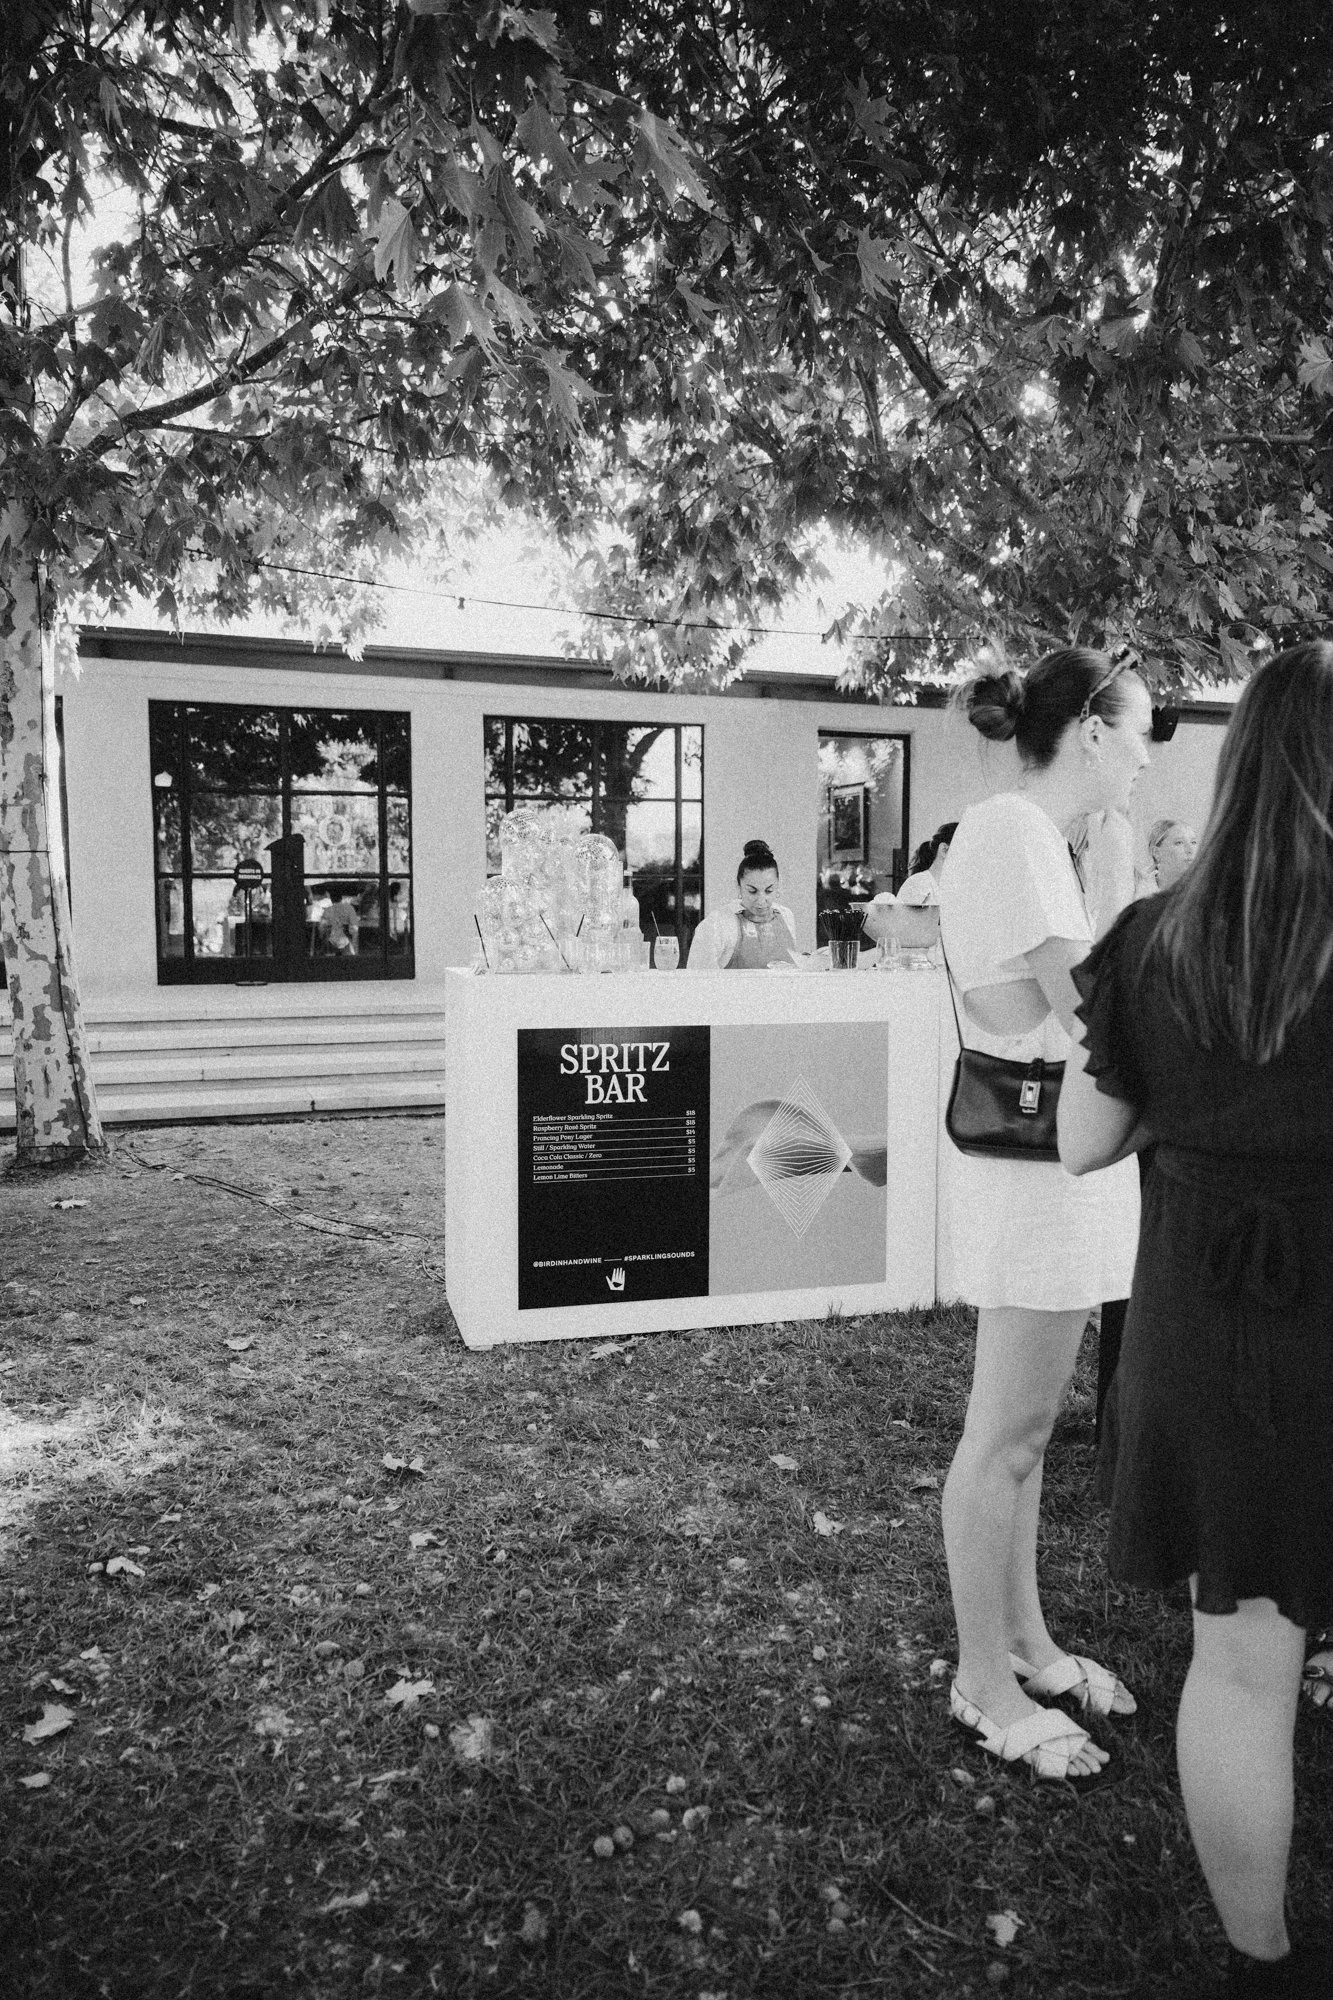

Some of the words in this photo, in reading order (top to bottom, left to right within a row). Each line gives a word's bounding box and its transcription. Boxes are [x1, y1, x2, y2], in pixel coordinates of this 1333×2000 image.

[560, 1042, 670, 1074] SPRITZ
[584, 1073, 648, 1104] BAR
[533, 1258, 602, 1267] @BIRDINHANDWINE
[624, 1252, 695, 1261] #SPARKLINGSOUNDS
